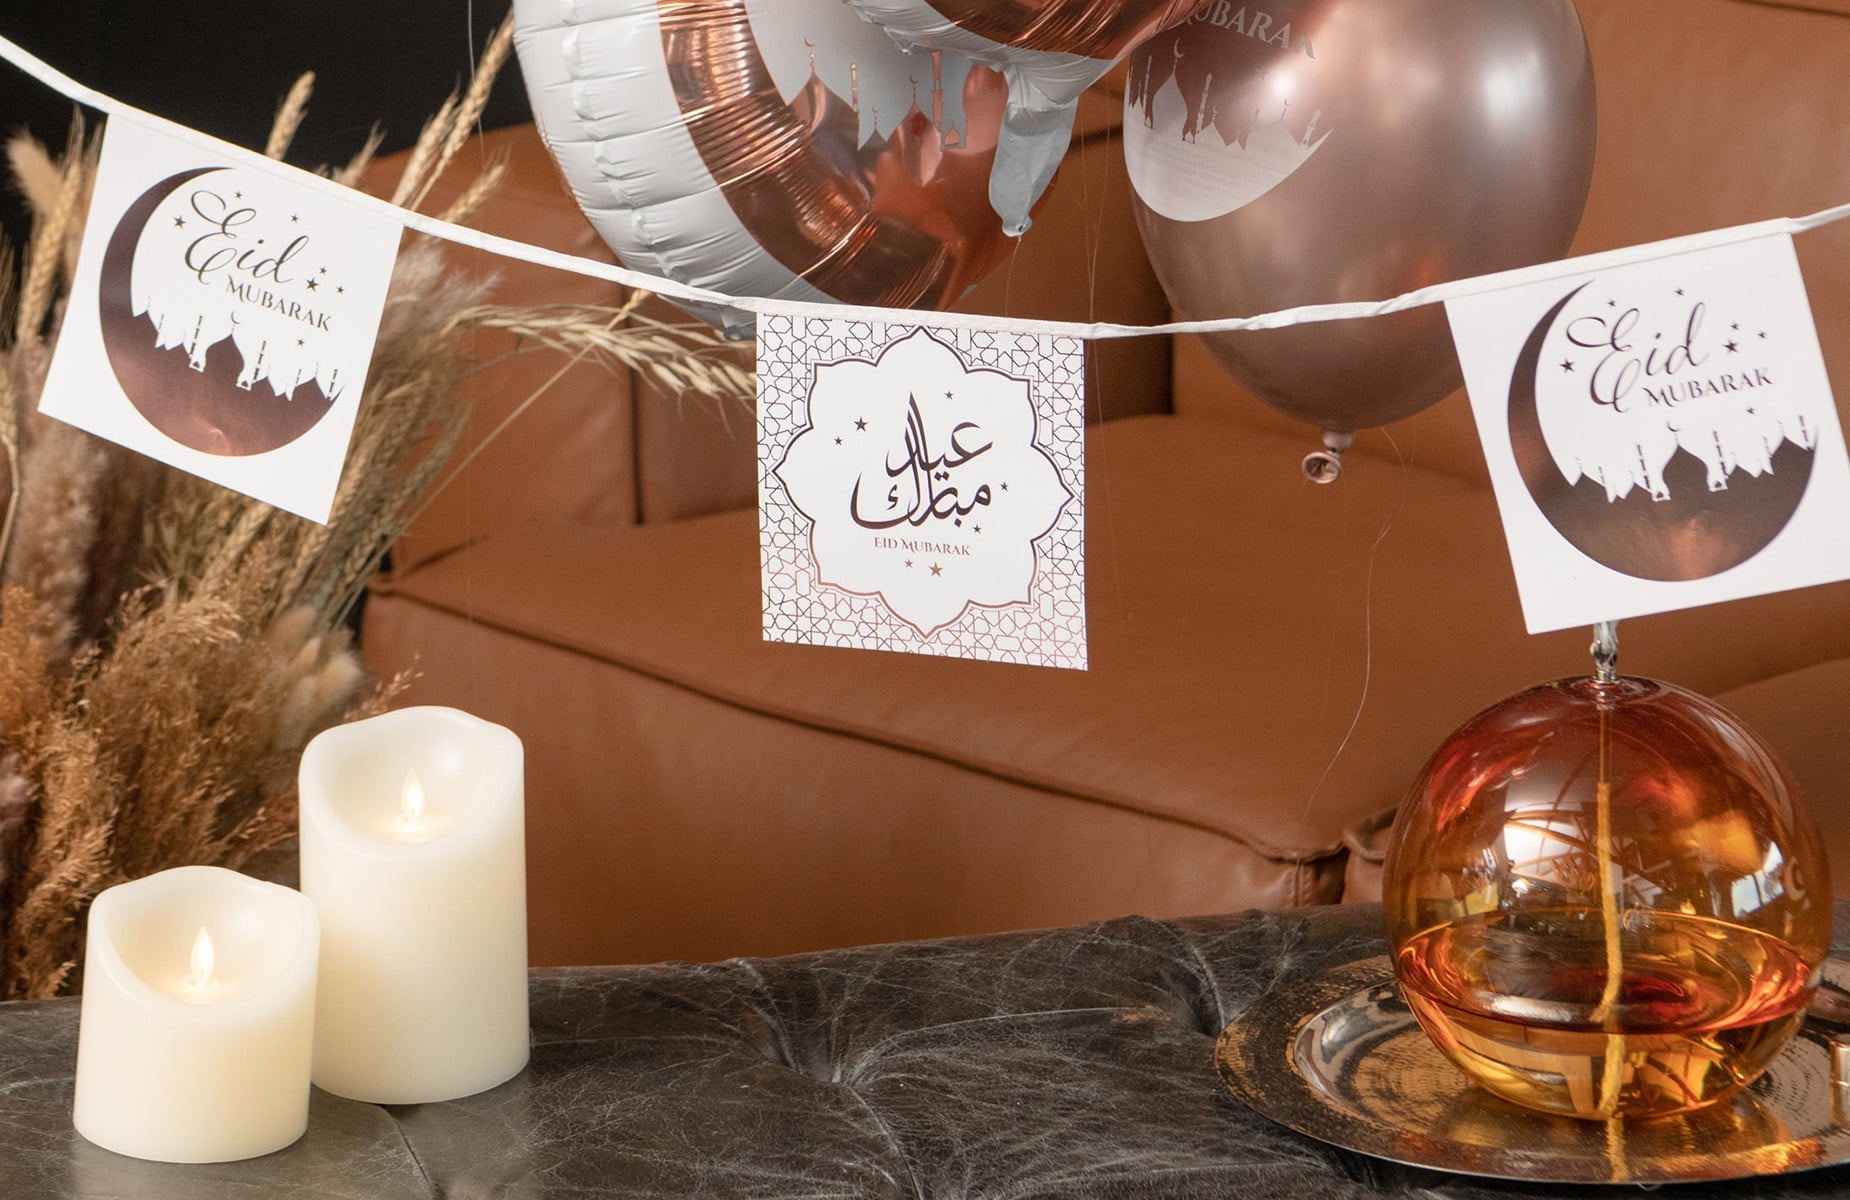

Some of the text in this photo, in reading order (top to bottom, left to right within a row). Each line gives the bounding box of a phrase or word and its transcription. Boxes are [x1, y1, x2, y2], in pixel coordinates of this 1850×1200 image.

[184, 189, 310, 286] Eid
[225, 273, 333, 333] MUBARAK
[1565, 301, 1711, 414] Eid
[1642, 365, 1774, 408] MUBARAK
[885, 409, 994, 481] عيد
[874, 536, 971, 557] EID MUBARAK
